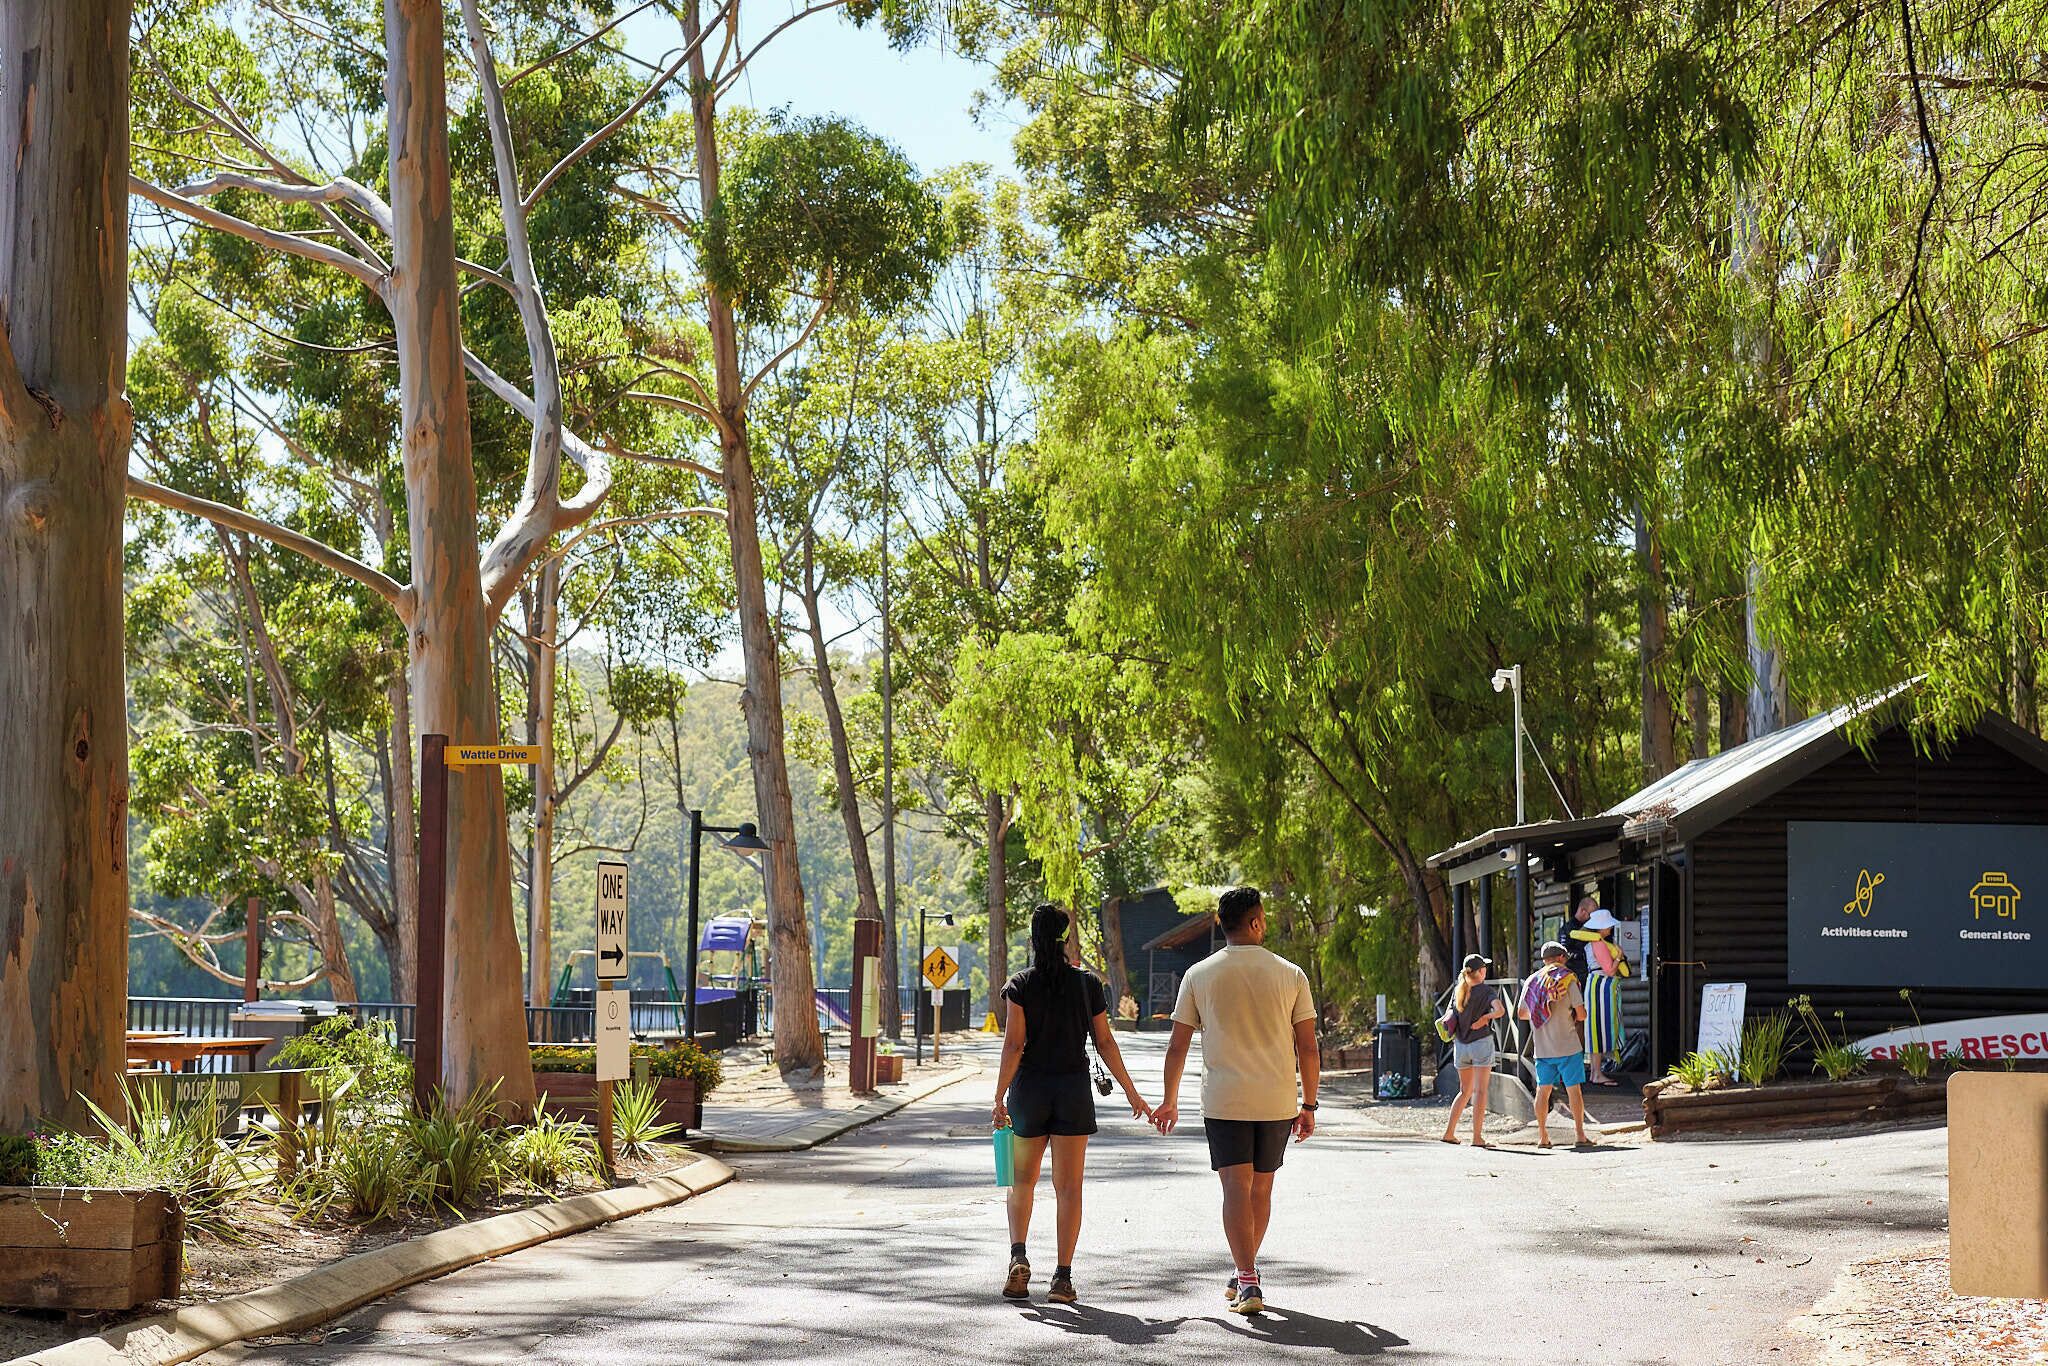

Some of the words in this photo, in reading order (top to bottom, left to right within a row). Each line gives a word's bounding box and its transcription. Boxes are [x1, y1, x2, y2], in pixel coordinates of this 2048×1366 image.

[460, 750, 496, 759] Wattle
[498, 749, 528, 759] Drive
[602, 873, 623, 900] ONE
[600, 909, 624, 935] WAY
[1821, 926, 1872, 937] Activities
[1872, 928, 1908, 938] centre
[1959, 929, 2002, 940] General
[2002, 931, 2031, 940] store
[176, 1081, 191, 1101] NO
[191, 1080, 240, 1101] LIFUARD
